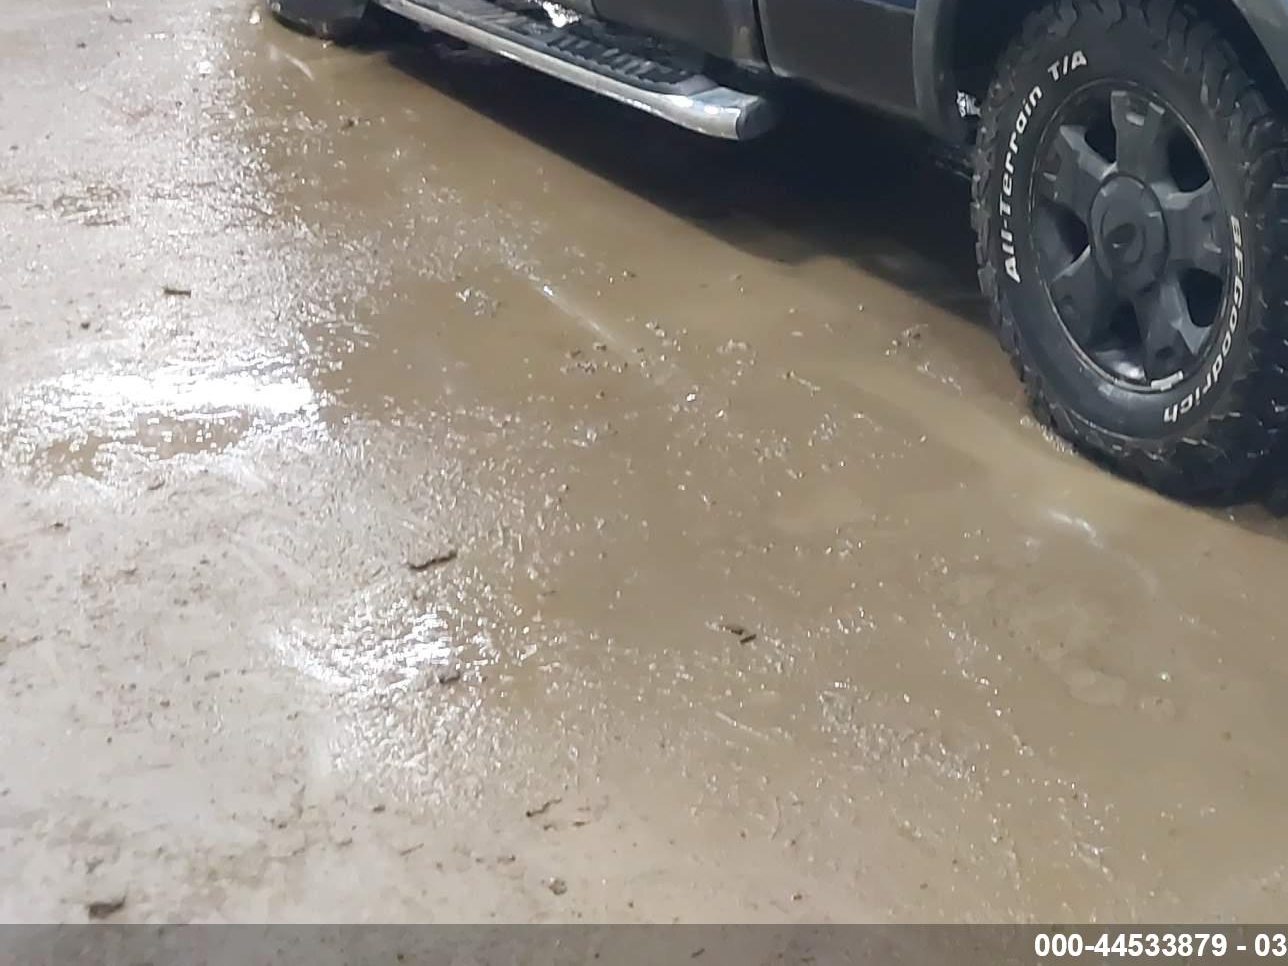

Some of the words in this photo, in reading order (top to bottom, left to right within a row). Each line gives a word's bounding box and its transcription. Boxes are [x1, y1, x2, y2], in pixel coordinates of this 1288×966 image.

[1000, 85, 1043, 284] All-Terrain
[1047, 50, 1088, 82] T/A
[1163, 214, 1244, 423] BFGoodrich
